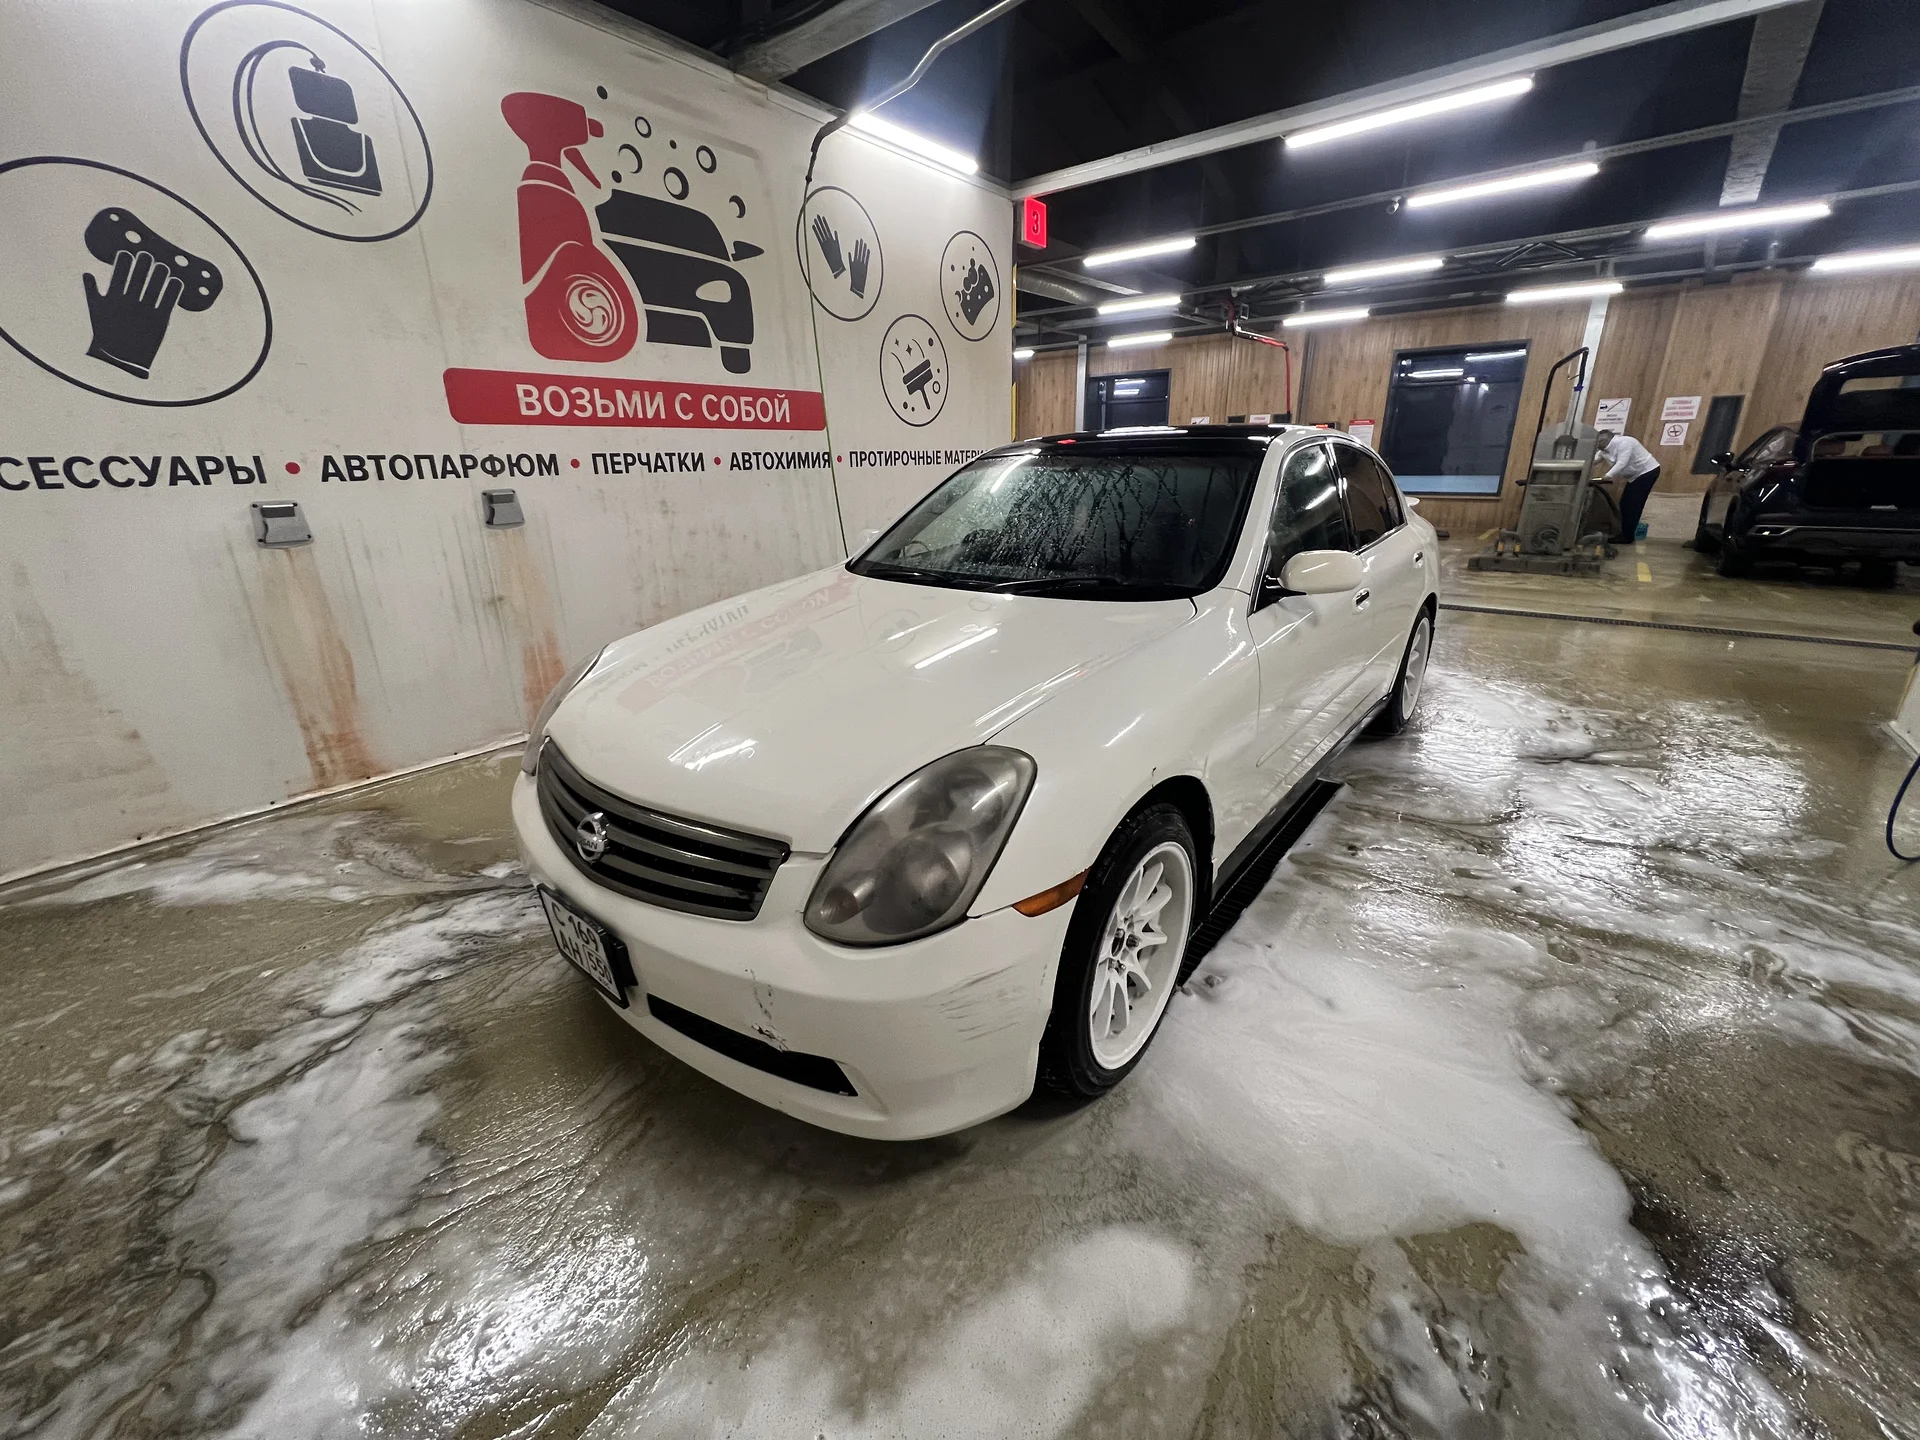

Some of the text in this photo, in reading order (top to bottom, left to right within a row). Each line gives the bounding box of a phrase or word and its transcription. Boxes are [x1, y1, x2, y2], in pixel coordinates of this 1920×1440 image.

[1032, 210, 1040, 235] 3
[516, 384, 791, 423] ВОЗЬМИ С СОБОЙ
[0, 455, 267, 491] СЕССУАРЫ
[321, 453, 560, 482] АВТОПАРФЮМ
[591, 452, 705, 474] ПЕРЧАТКИ
[729, 451, 831, 471] АВТОХИМИЯ
[849, 450, 941, 467] ПРОТИРОЧНЫЕ
[552, 901, 566, 927] С
[560, 929, 584, 966] АН
